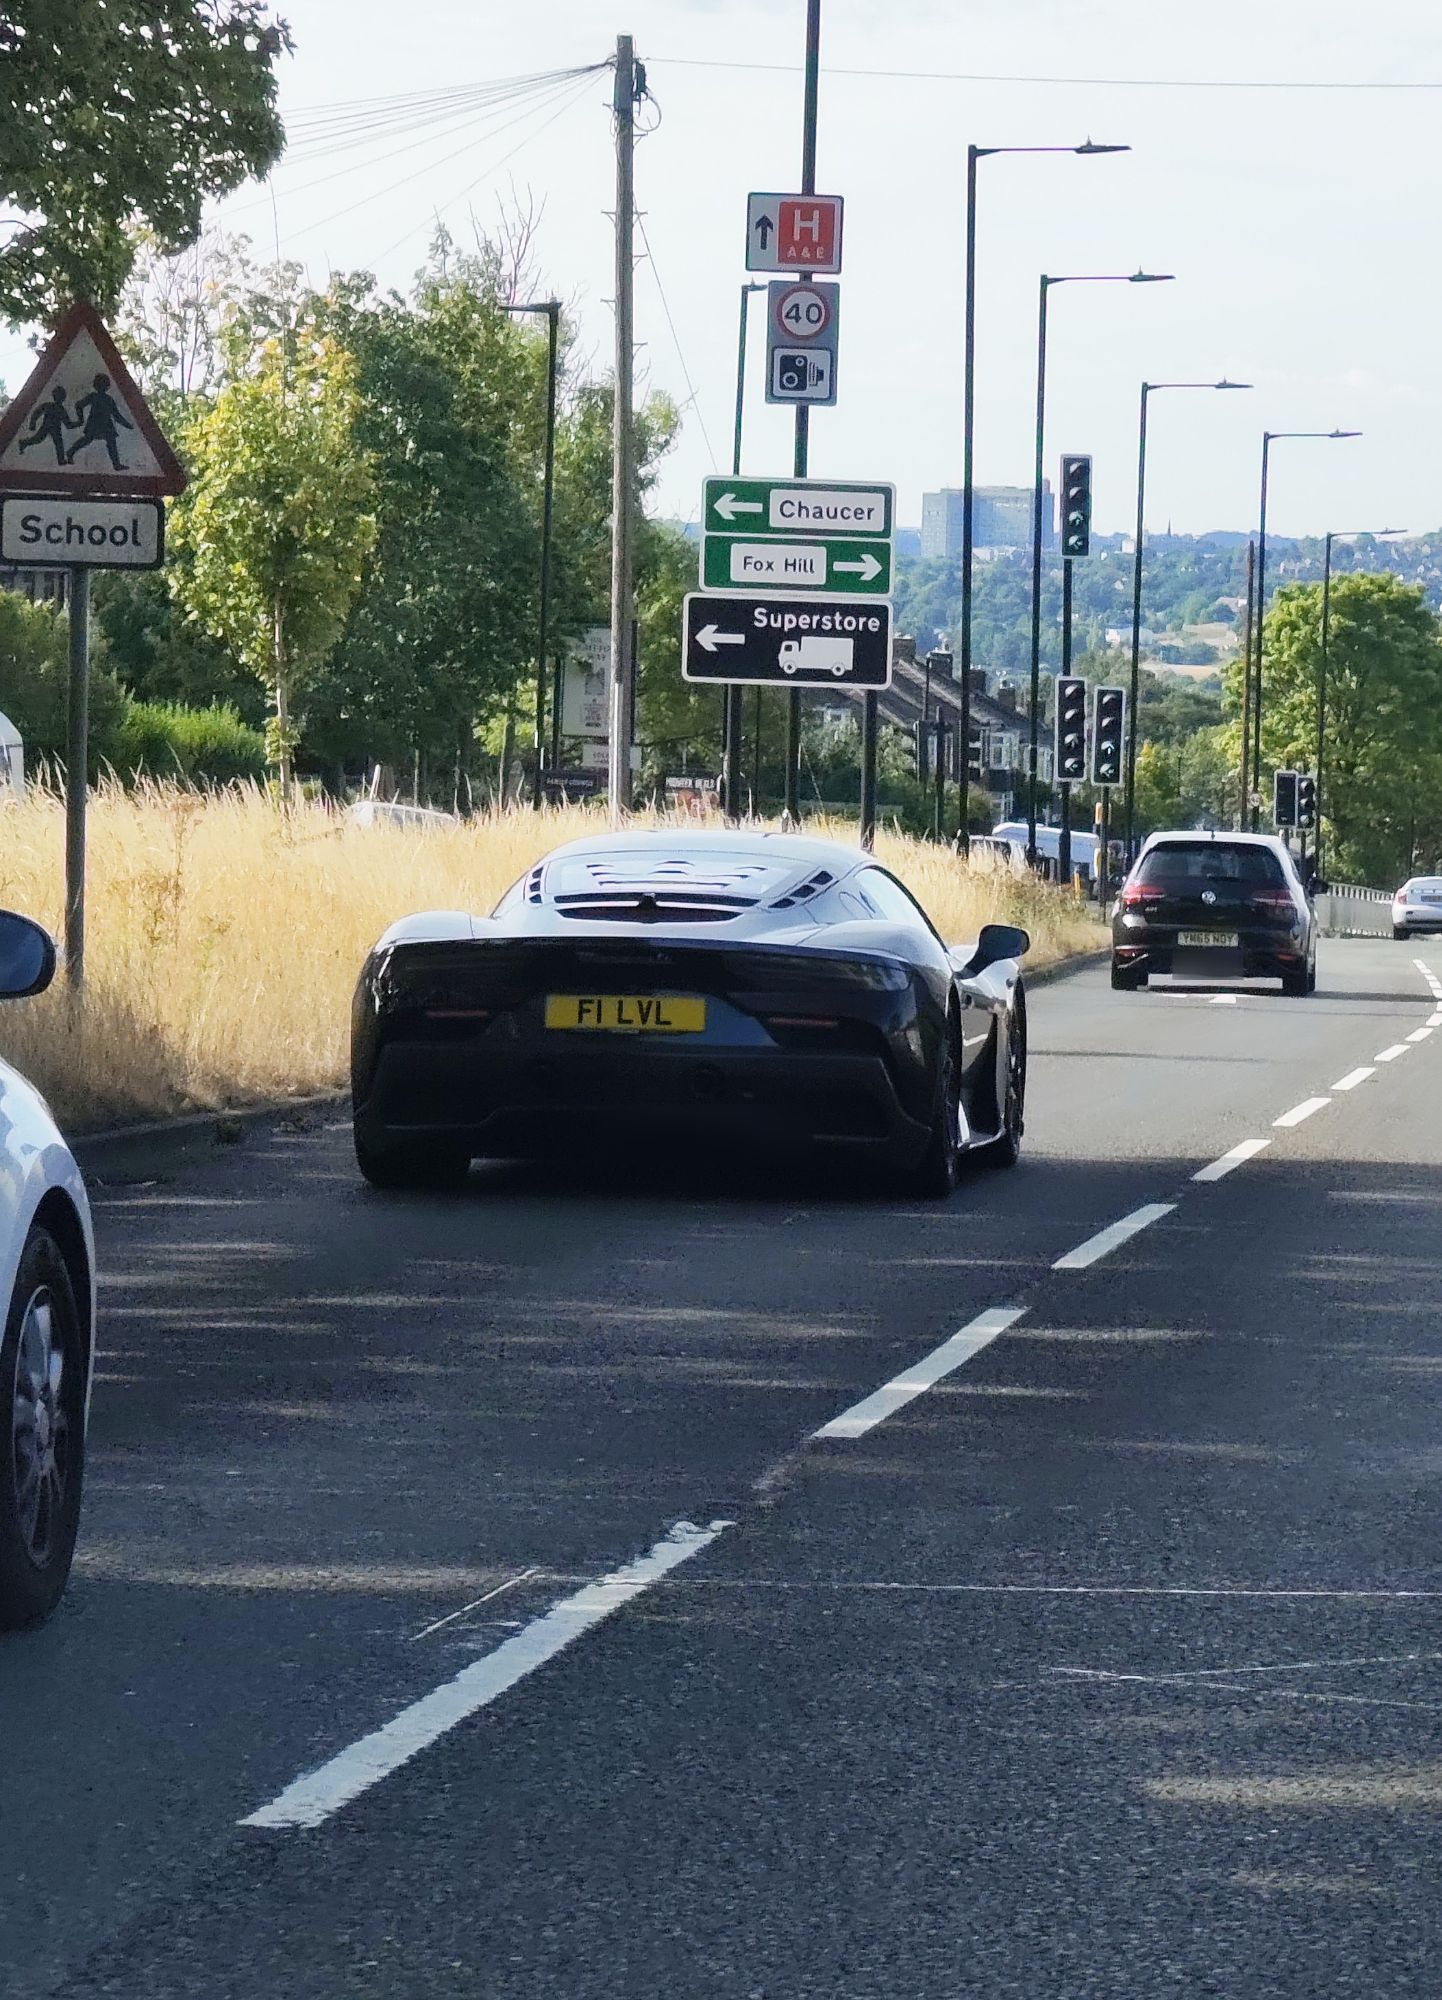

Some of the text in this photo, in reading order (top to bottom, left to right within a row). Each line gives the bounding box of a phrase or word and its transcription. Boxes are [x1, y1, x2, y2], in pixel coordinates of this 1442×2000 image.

[793, 208, 820, 243] H
[784, 302, 823, 324] 40
[778, 499, 876, 521] Chaucer
[18, 514, 142, 547] School
[742, 555, 815, 574] Fox Hill
[753, 607, 881, 632] Superstore
[617, 1000, 672, 1026] LVL
